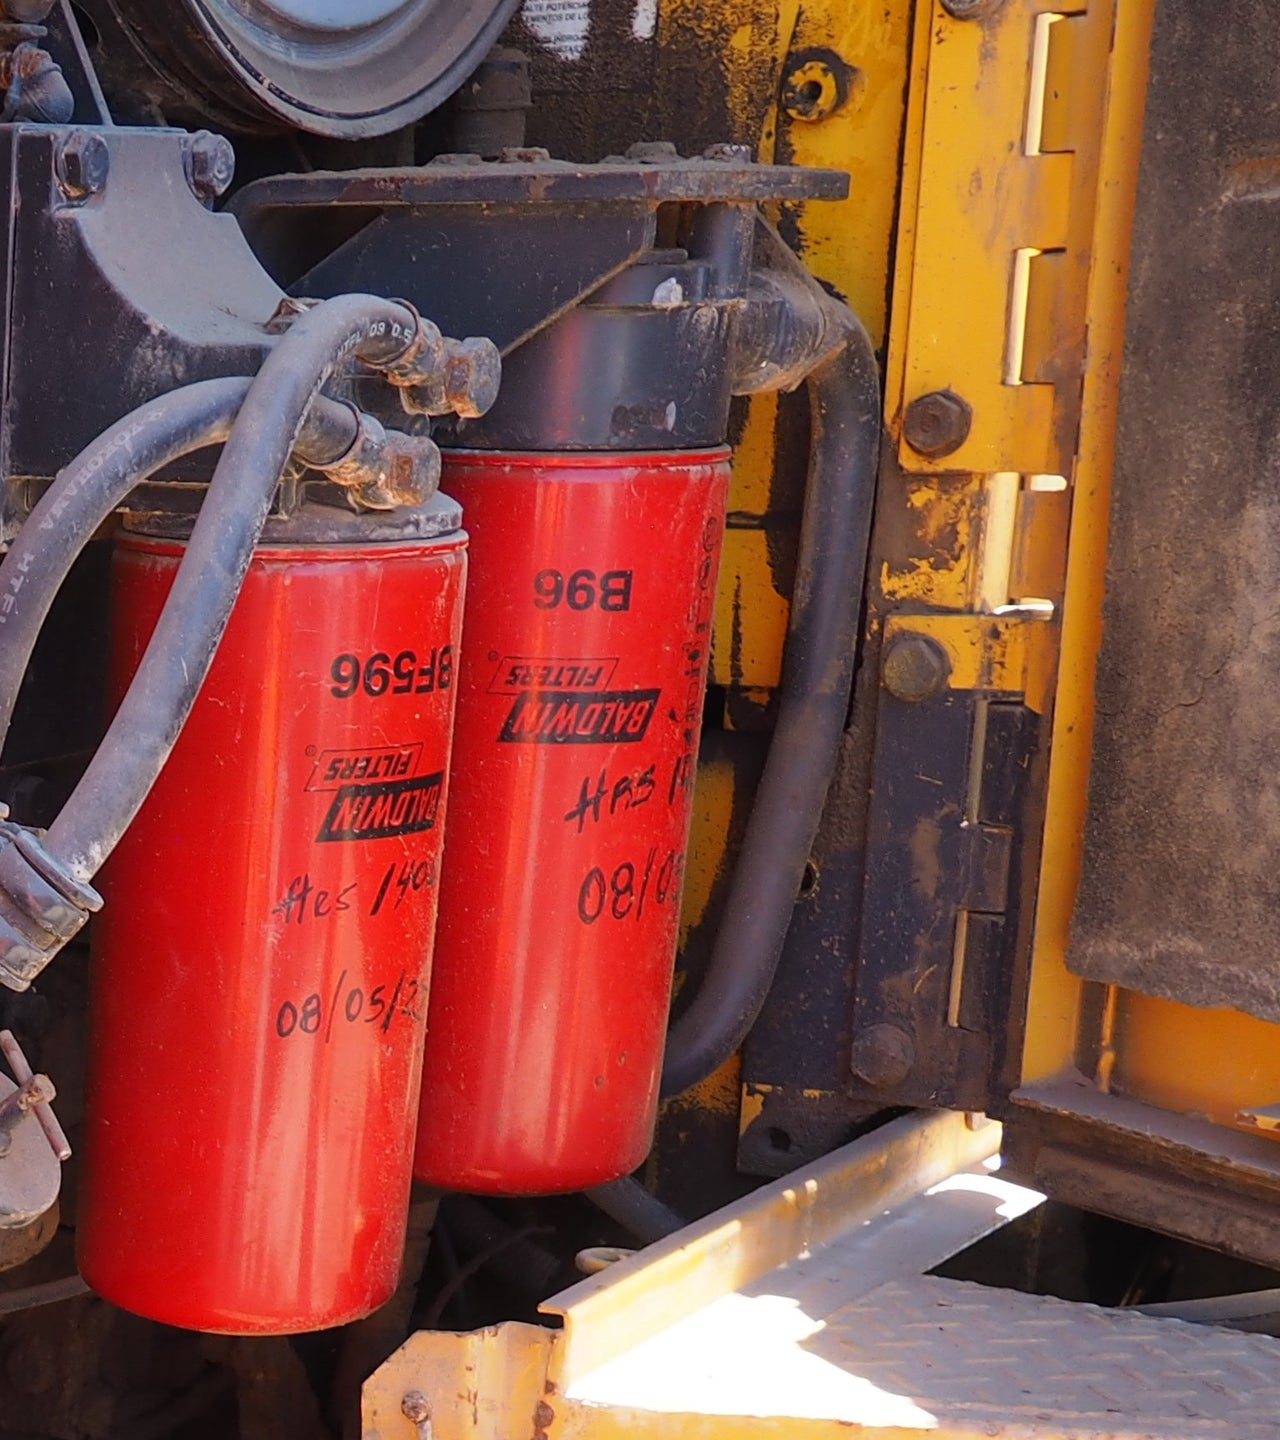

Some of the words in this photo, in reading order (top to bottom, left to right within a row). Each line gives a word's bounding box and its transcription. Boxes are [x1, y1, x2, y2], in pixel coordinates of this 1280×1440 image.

[533, 568, 633, 612] B96
[505, 664, 605, 687] FILTERS
[512, 699, 652, 735] BALDWIN
[324, 751, 414, 781] FILTERS
